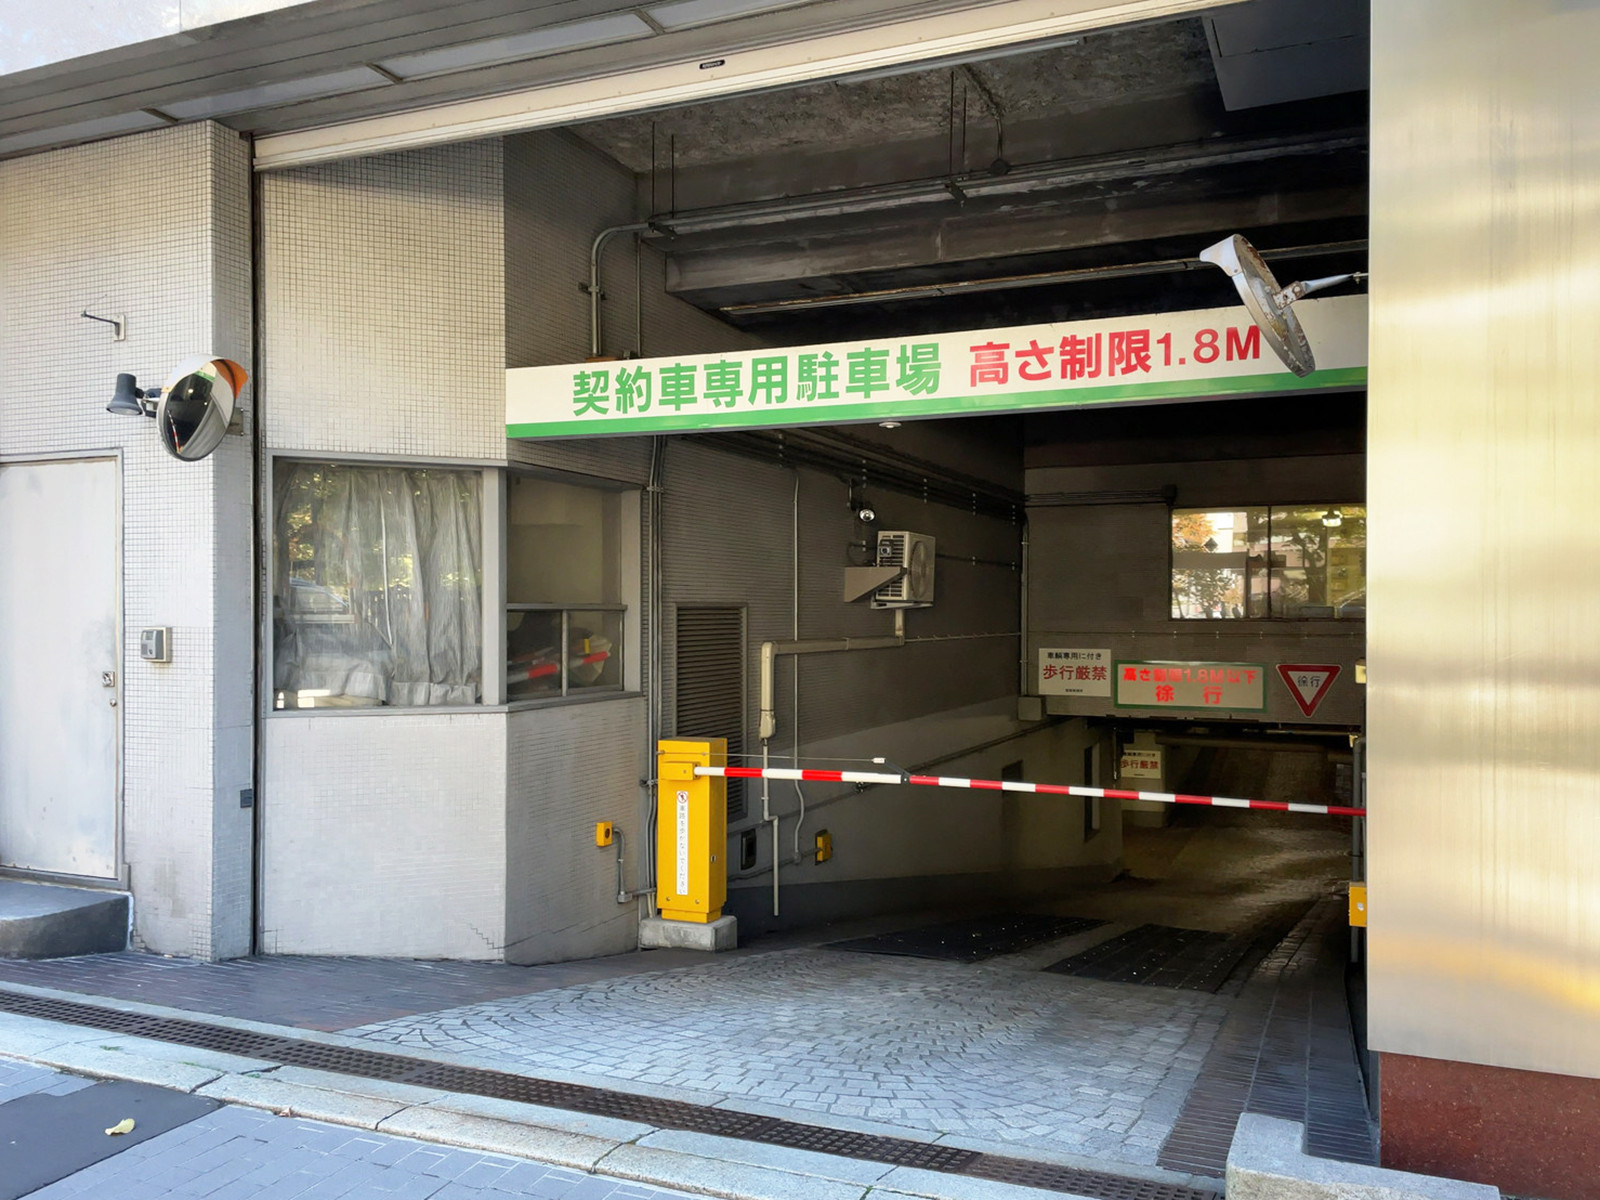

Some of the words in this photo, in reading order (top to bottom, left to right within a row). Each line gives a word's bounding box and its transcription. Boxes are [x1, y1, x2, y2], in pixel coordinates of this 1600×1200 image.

[572, 342, 941, 417] 契約車専用駐車場
[969, 324, 1262, 387] 高さ制限1.8M
[1043, 664, 1107, 682] 歩行厳禁
[1297, 675, 1321, 688] 徐行
